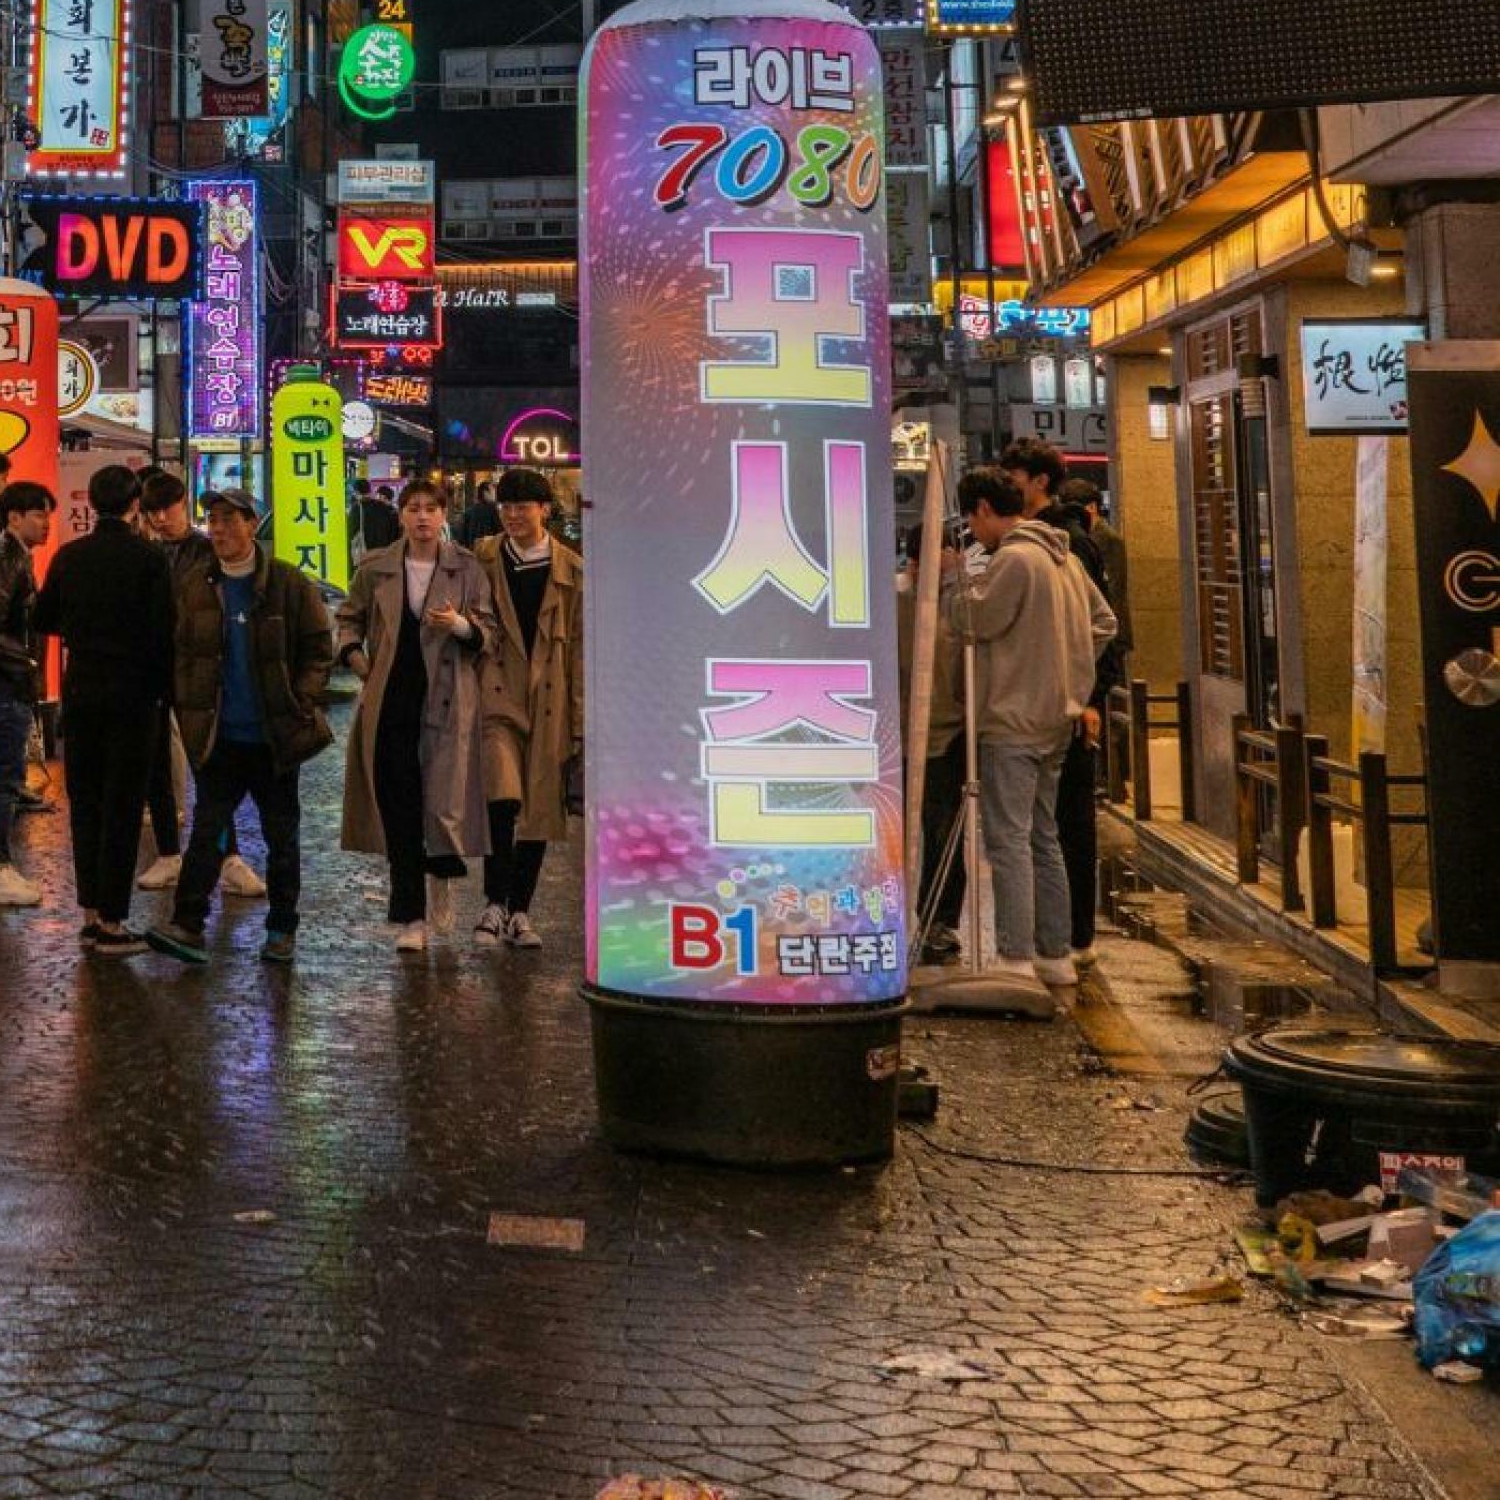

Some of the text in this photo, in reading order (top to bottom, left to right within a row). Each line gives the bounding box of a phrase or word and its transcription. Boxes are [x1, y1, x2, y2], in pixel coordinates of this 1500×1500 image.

[694, 48, 855, 111] 라이브
[655, 124, 880, 211] 7080
[56, 212, 191, 285] DVD
[348, 226, 427, 269] VR
[205, 246, 243, 406] 노래연습장
[346, 315, 429, 336] 노래연습장
[287, 419, 333, 437] 넥타이
[293, 449, 329, 580] 마사지
[691, 227, 879, 848] 포시즌
[668, 902, 760, 975] B1
[778, 930, 899, 976] 단란주점
